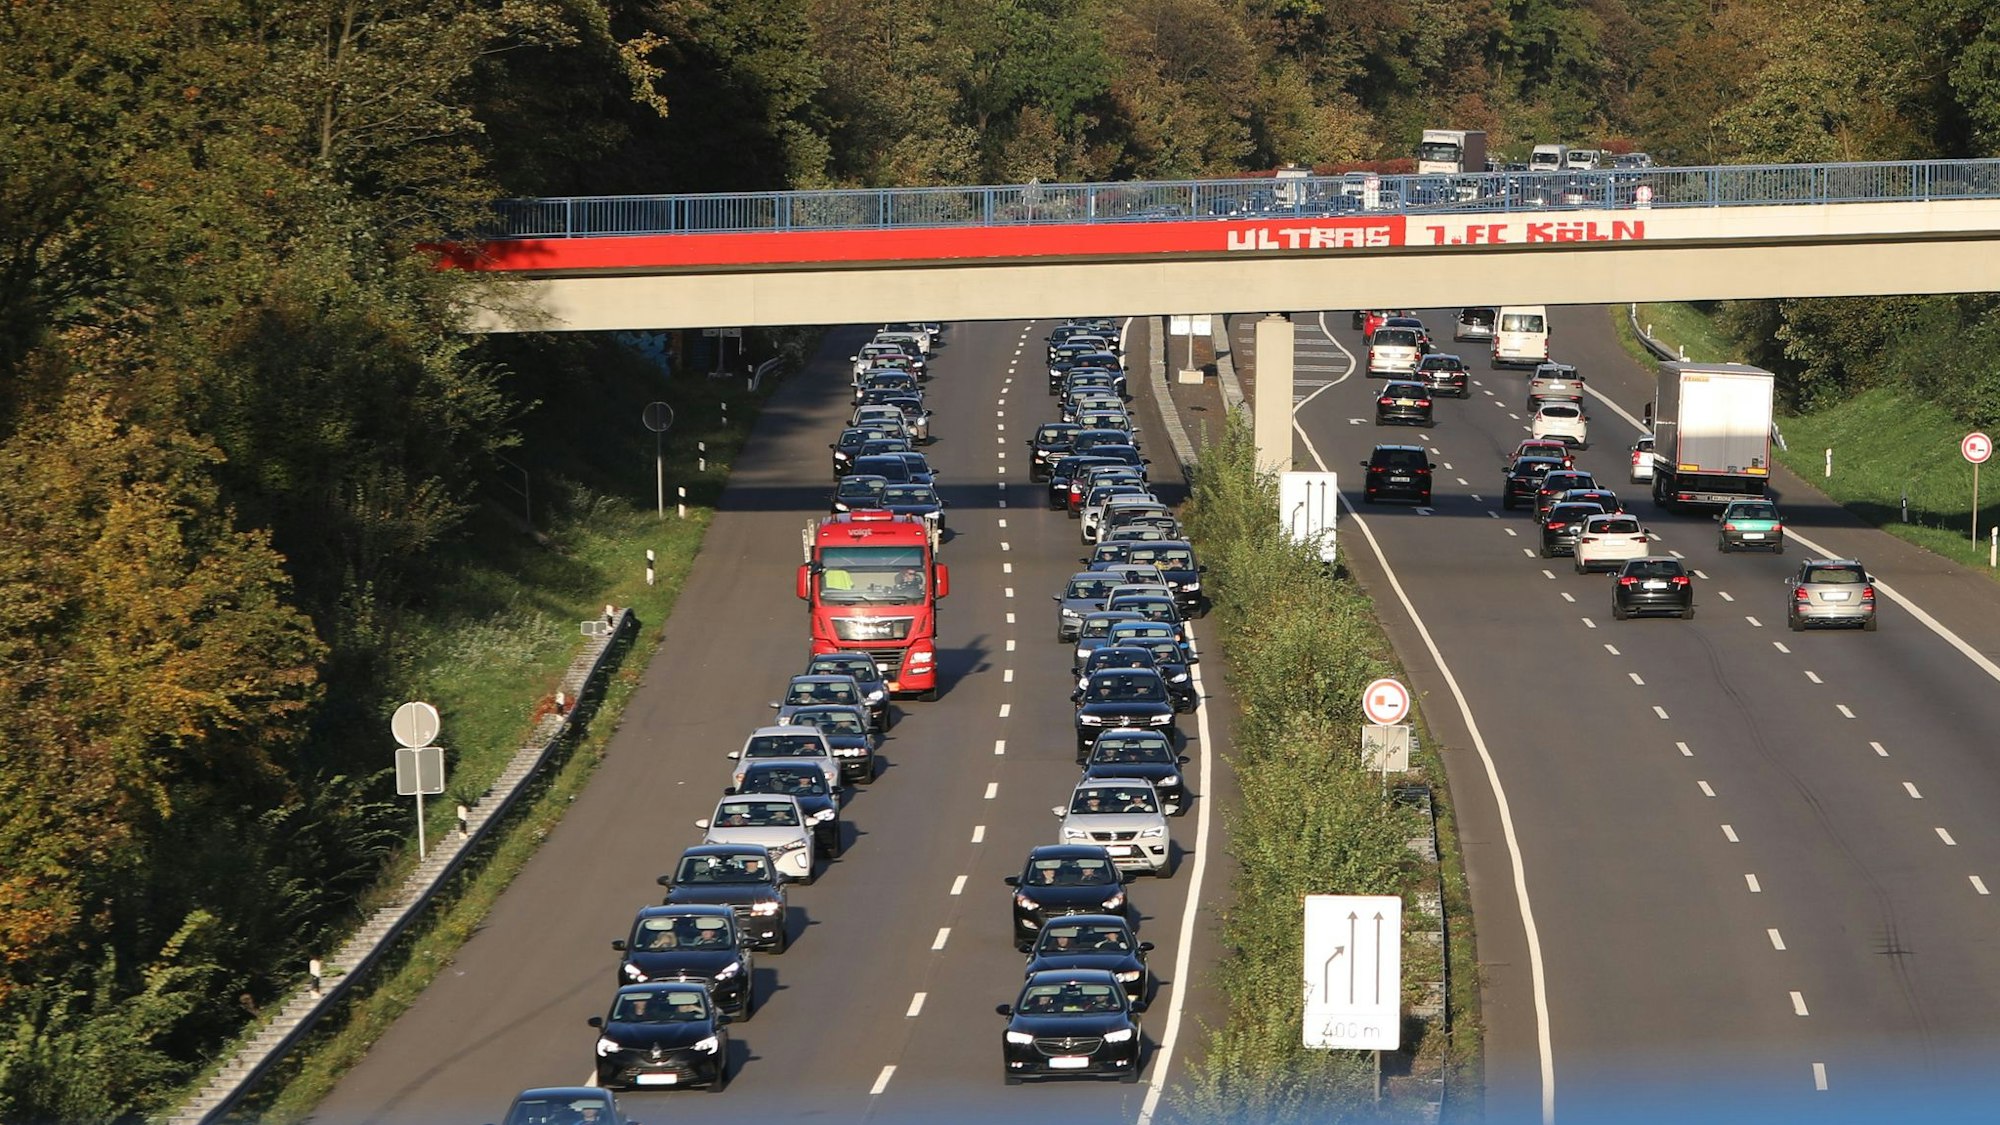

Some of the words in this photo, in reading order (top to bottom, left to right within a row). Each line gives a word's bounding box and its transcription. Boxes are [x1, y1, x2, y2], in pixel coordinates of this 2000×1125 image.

[1228, 226, 1390, 250] ULTRAS
[1322, 1019, 1357, 1038] 400
[1364, 1026, 1380, 1039] m
